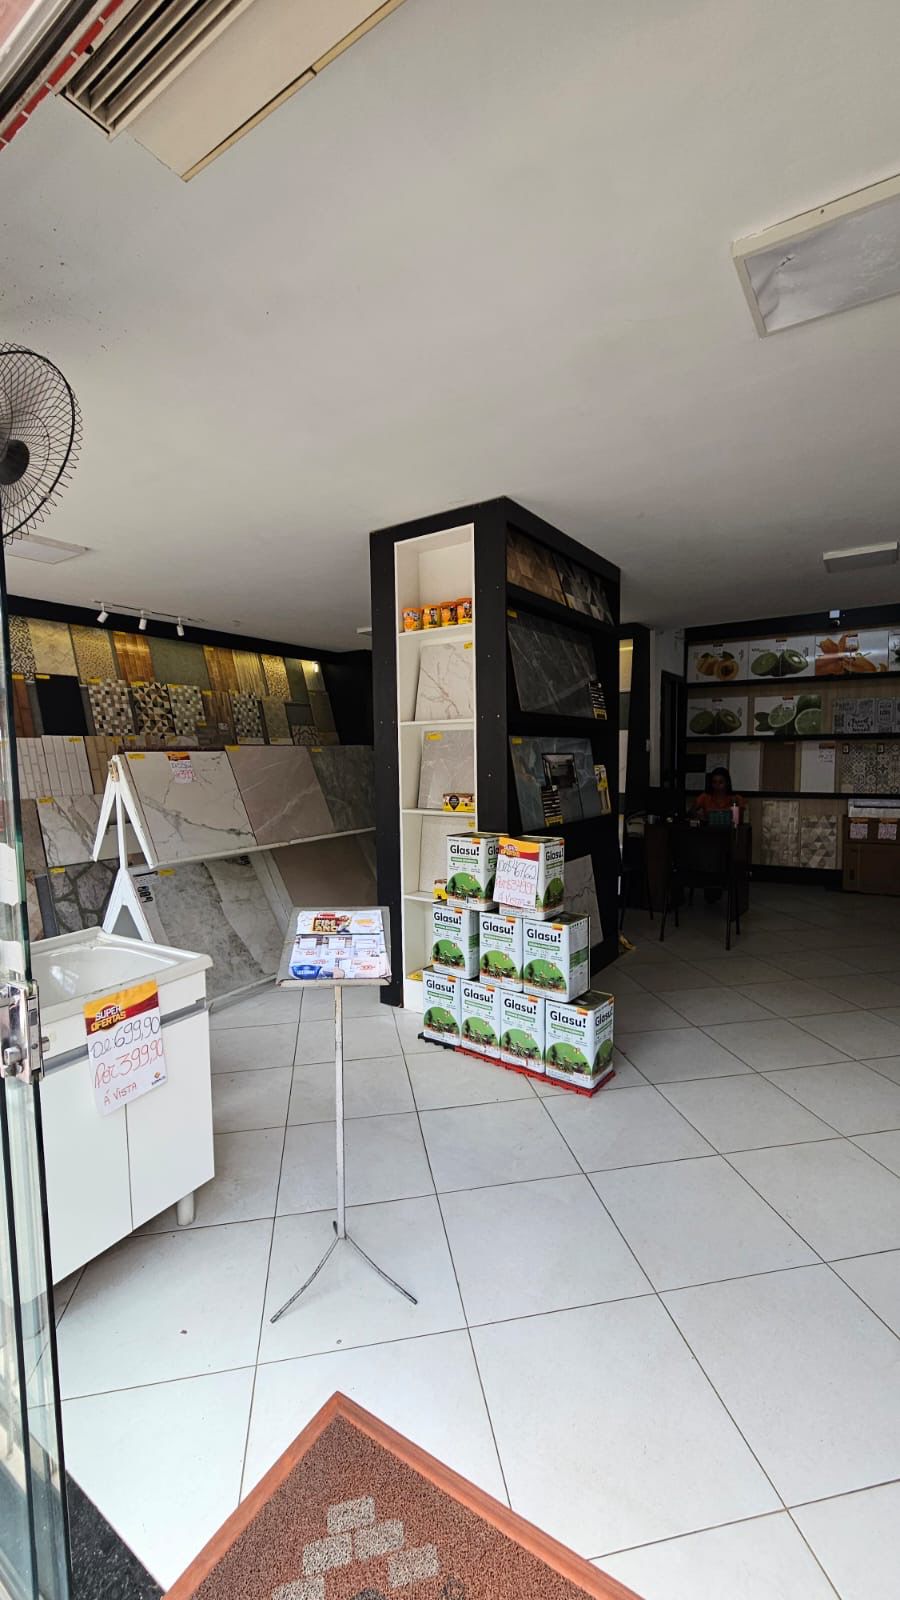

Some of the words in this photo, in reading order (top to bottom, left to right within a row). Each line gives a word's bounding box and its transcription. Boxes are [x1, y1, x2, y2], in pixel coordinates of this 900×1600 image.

[449, 844, 480, 857] Glasu!
[545, 848, 564, 861] Glasu!
[433, 911, 462, 925] Glasu!
[482, 920, 514, 936] Glasu!
[526, 928, 562, 943] Glasu!
[426, 979, 455, 994] Glasu!
[463, 987, 494, 1004] Glasu!
[95, 1005, 122, 1020] SUPER
[504, 998, 537, 1015] Glasu!
[90, 1011, 127, 1032] OFERTAS
[550, 1010, 587, 1028] Glasu!
[595, 1006, 613, 1026] Glasu!
[114, 1016, 161, 1048] 699,90
[113, 1082, 138, 1101] VISTA
